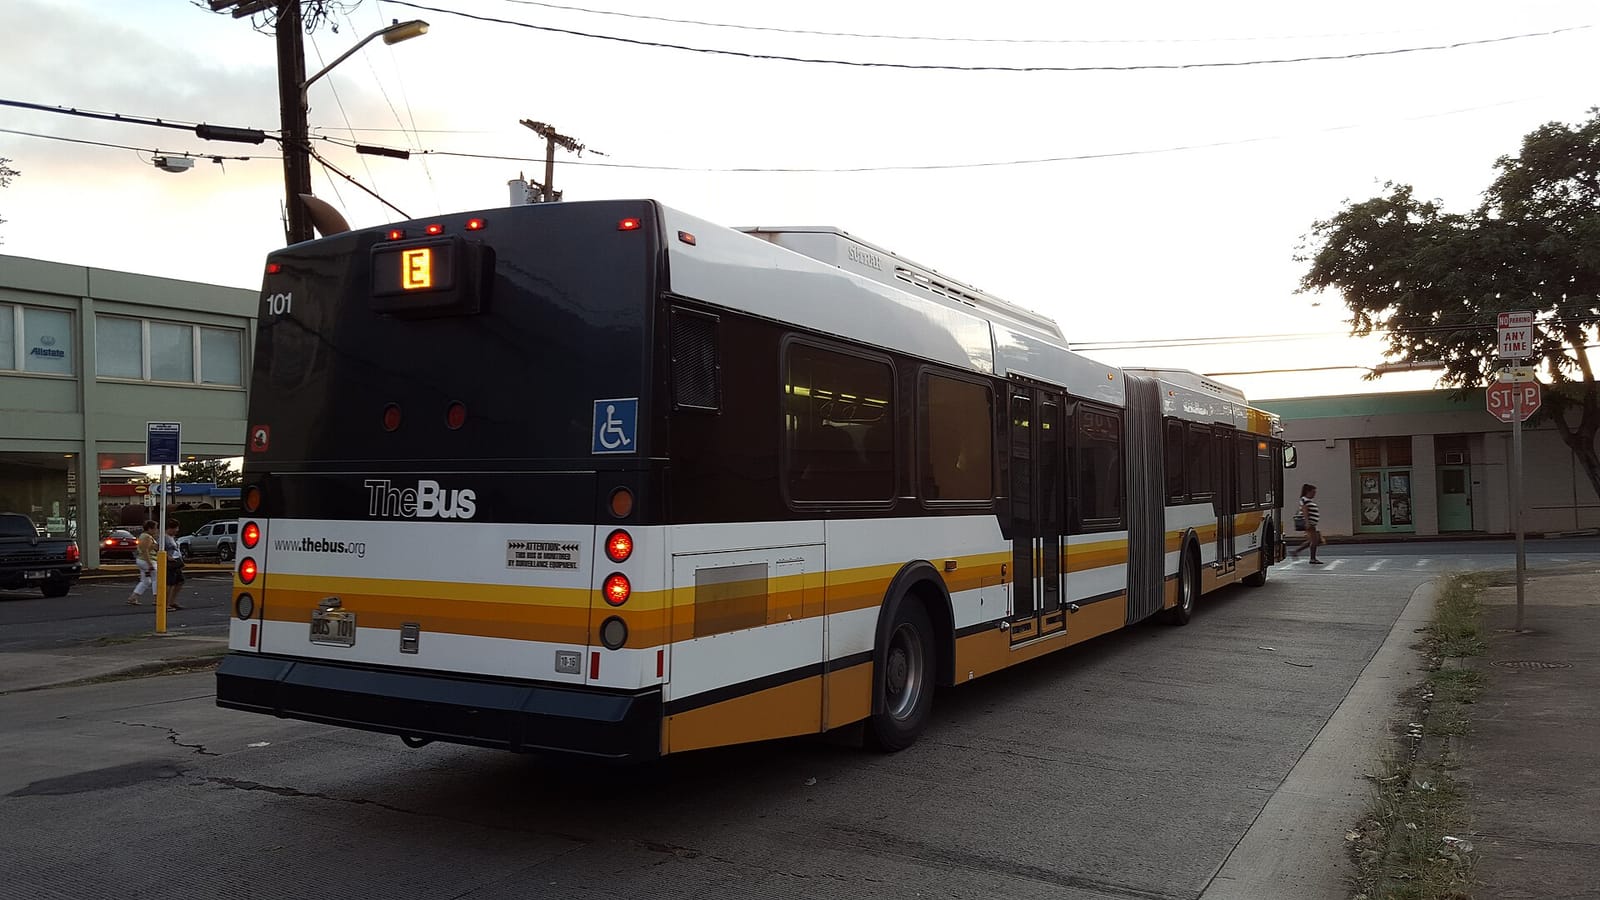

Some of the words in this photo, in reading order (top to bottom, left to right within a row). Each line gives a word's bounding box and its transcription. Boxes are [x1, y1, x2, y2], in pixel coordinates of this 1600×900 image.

[405, 251, 427, 287] E
[266, 292, 292, 315] 101
[1500, 315, 1510, 326] NO
[1510, 315, 1531, 324] PARKING
[1505, 331, 1526, 341] ANY
[30, 347, 65, 358] Allstate
[1503, 342, 1527, 352] TIME
[1490, 387, 1537, 408] STP
[274, 537, 366, 559] www.thebus.org
[337, 620, 353, 637] 101
